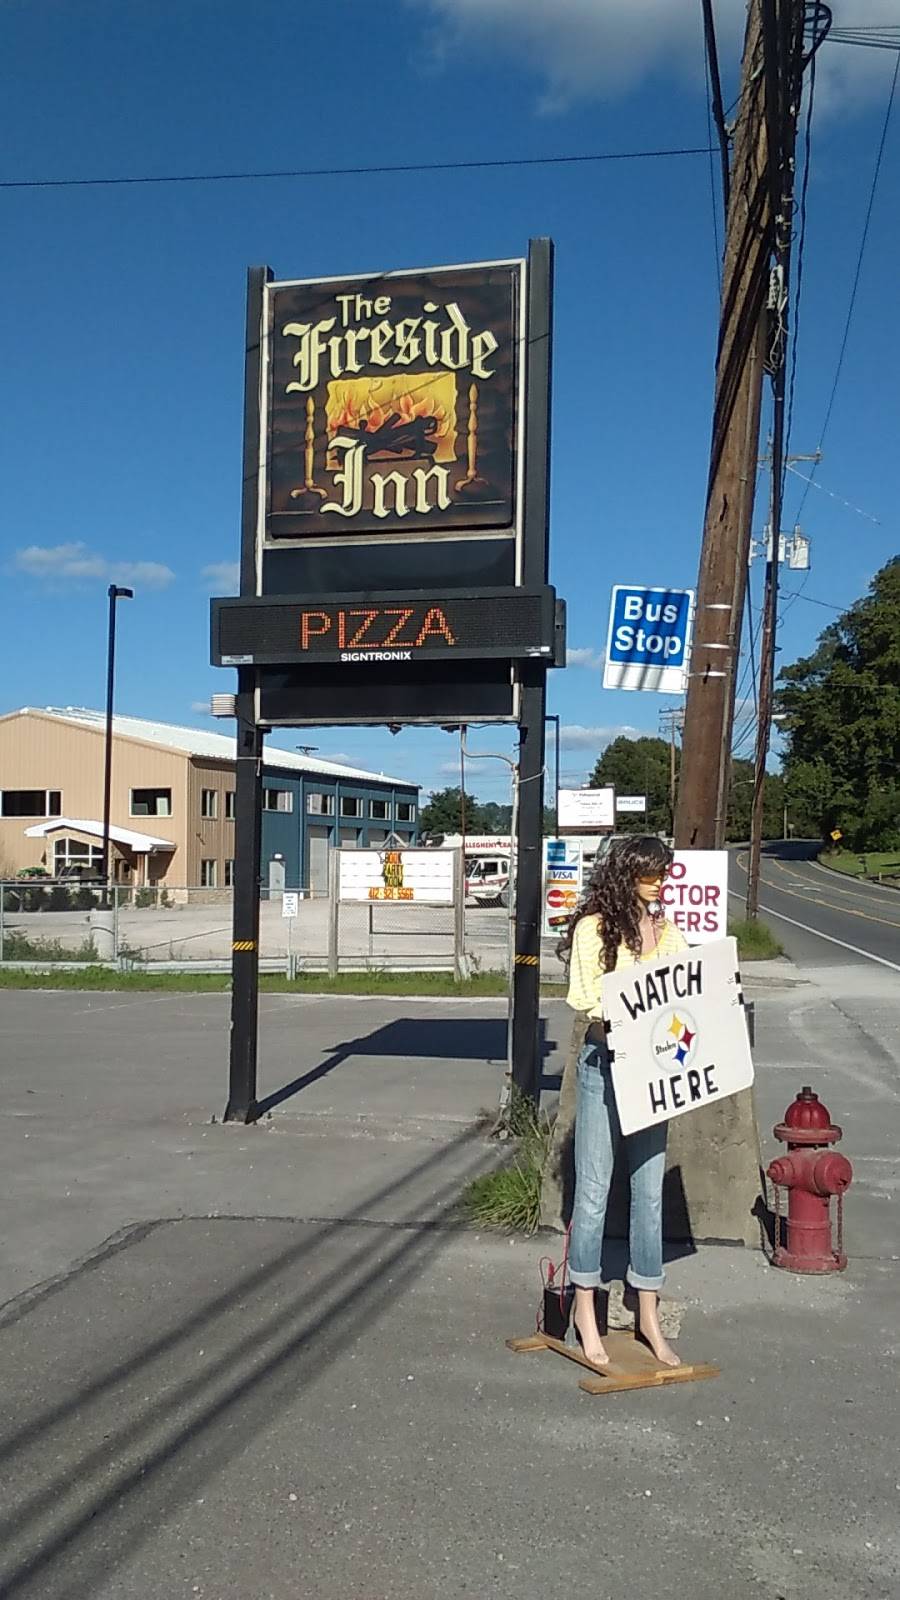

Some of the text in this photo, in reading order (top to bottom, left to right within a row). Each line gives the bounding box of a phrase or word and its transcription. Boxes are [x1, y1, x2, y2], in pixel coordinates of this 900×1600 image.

[336, 293, 392, 327] The
[282, 301, 499, 394] Fireside
[319, 435, 452, 518] Inn
[623, 595, 678, 624] Bus
[301, 607, 456, 650] PIZZA
[614, 625, 682, 659] Stop
[340, 651, 412, 662] SIGNTRONIX
[552, 871, 573, 880] VISA
[666, 862, 687, 880] O
[658, 884, 721, 907] CTOR
[619, 960, 703, 1021] WATCH
[648, 1064, 719, 1114] HERE
